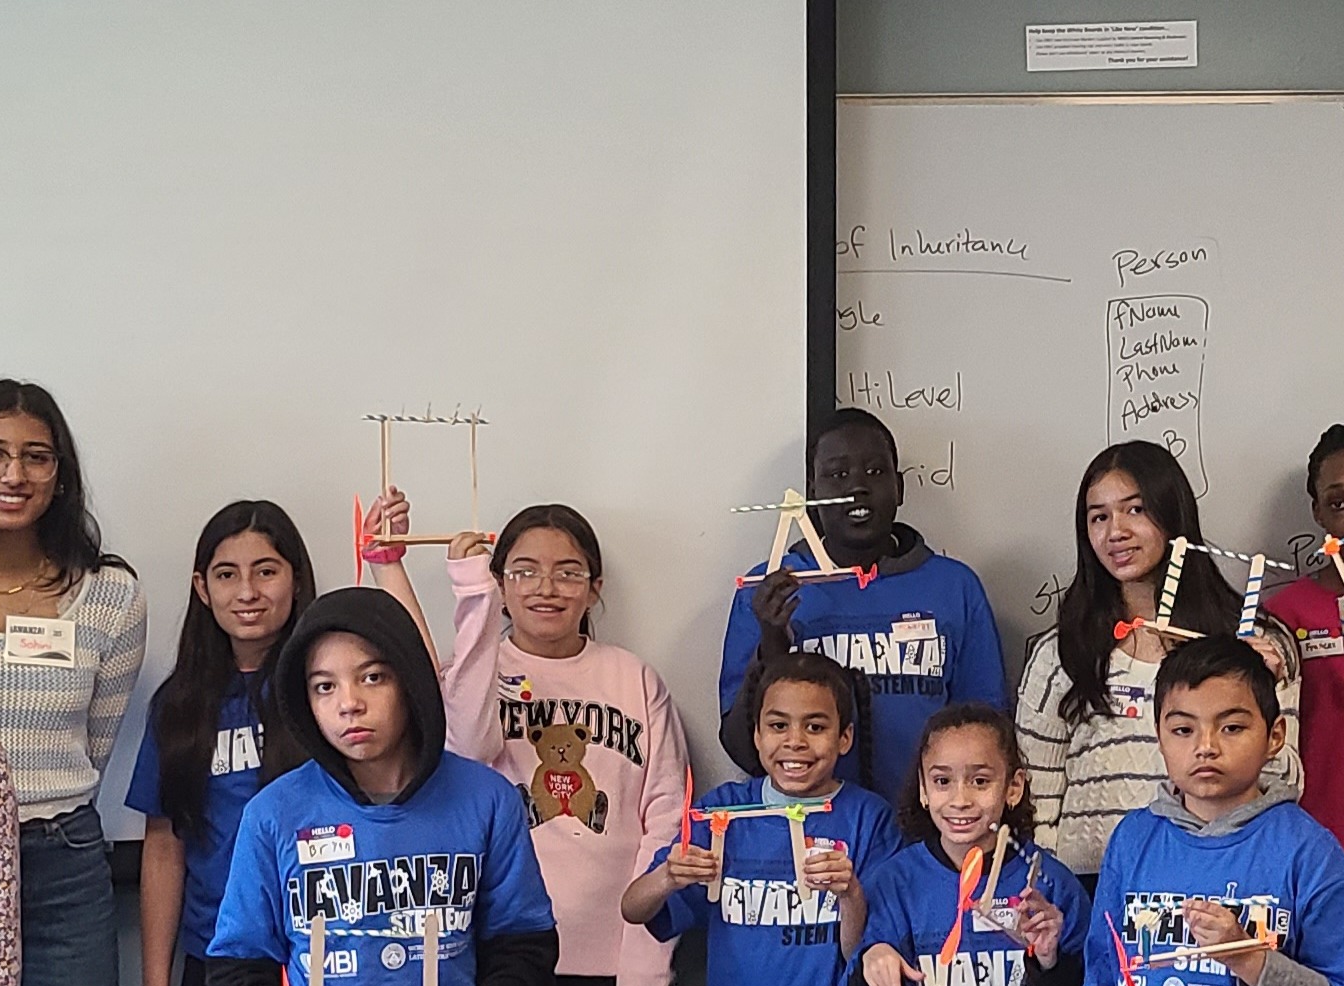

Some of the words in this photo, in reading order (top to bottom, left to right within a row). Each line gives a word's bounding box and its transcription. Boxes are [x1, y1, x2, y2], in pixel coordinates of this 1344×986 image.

[1112, 247, 1207, 287] Person
[557, 698, 646, 769] YORK
[549, 774, 571, 783] NEW
[549, 782, 575, 793] YORK
[551, 790, 573, 799] CITY
[311, 825, 336, 836] HELLO
[781, 925, 827, 946] STEM
